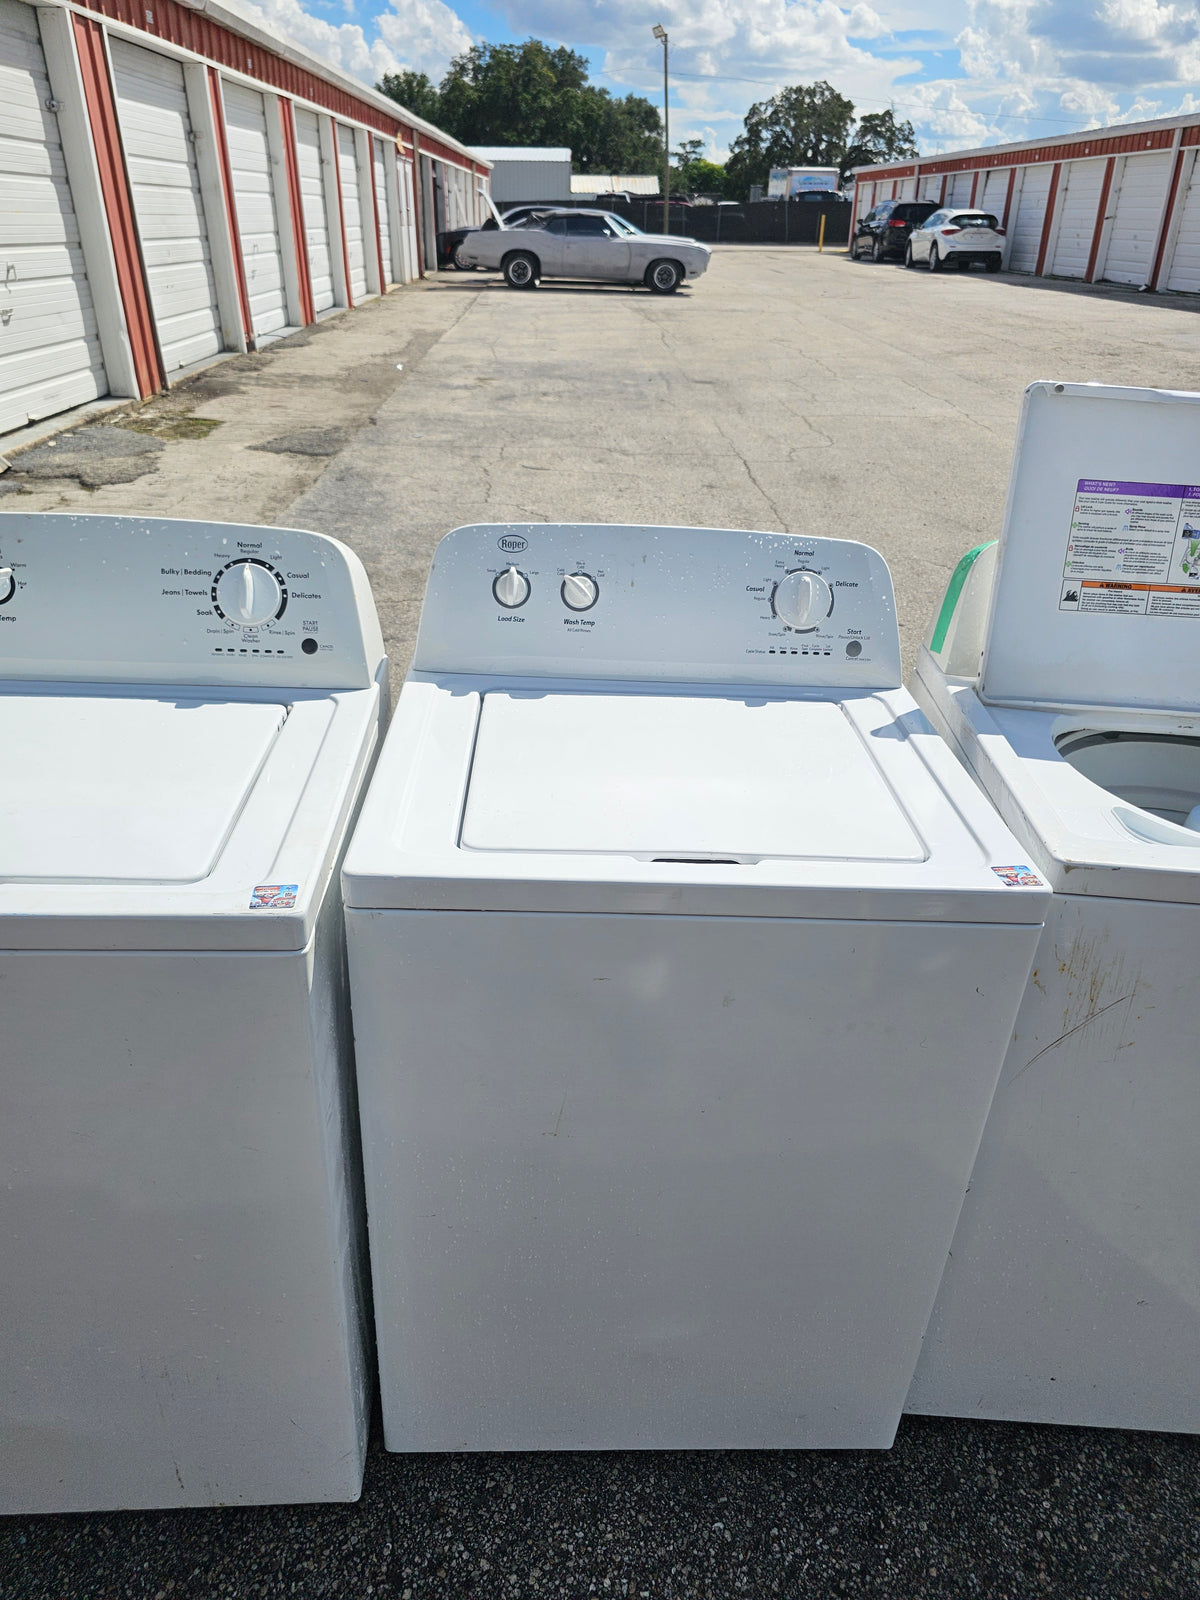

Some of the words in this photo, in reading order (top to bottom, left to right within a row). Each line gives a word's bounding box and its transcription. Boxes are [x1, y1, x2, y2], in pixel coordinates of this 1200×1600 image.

[237, 541, 263, 549] Normal
[501, 539, 526, 550] Roper
[160, 568, 181, 576] Bulky
[183, 569, 212, 577] Bedding
[286, 571, 310, 579] Casual
[835, 580, 859, 588] Delicate
[291, 592, 322, 600] Delicates
[563, 618, 580, 626] Wash
[580, 619, 596, 627] Temp
